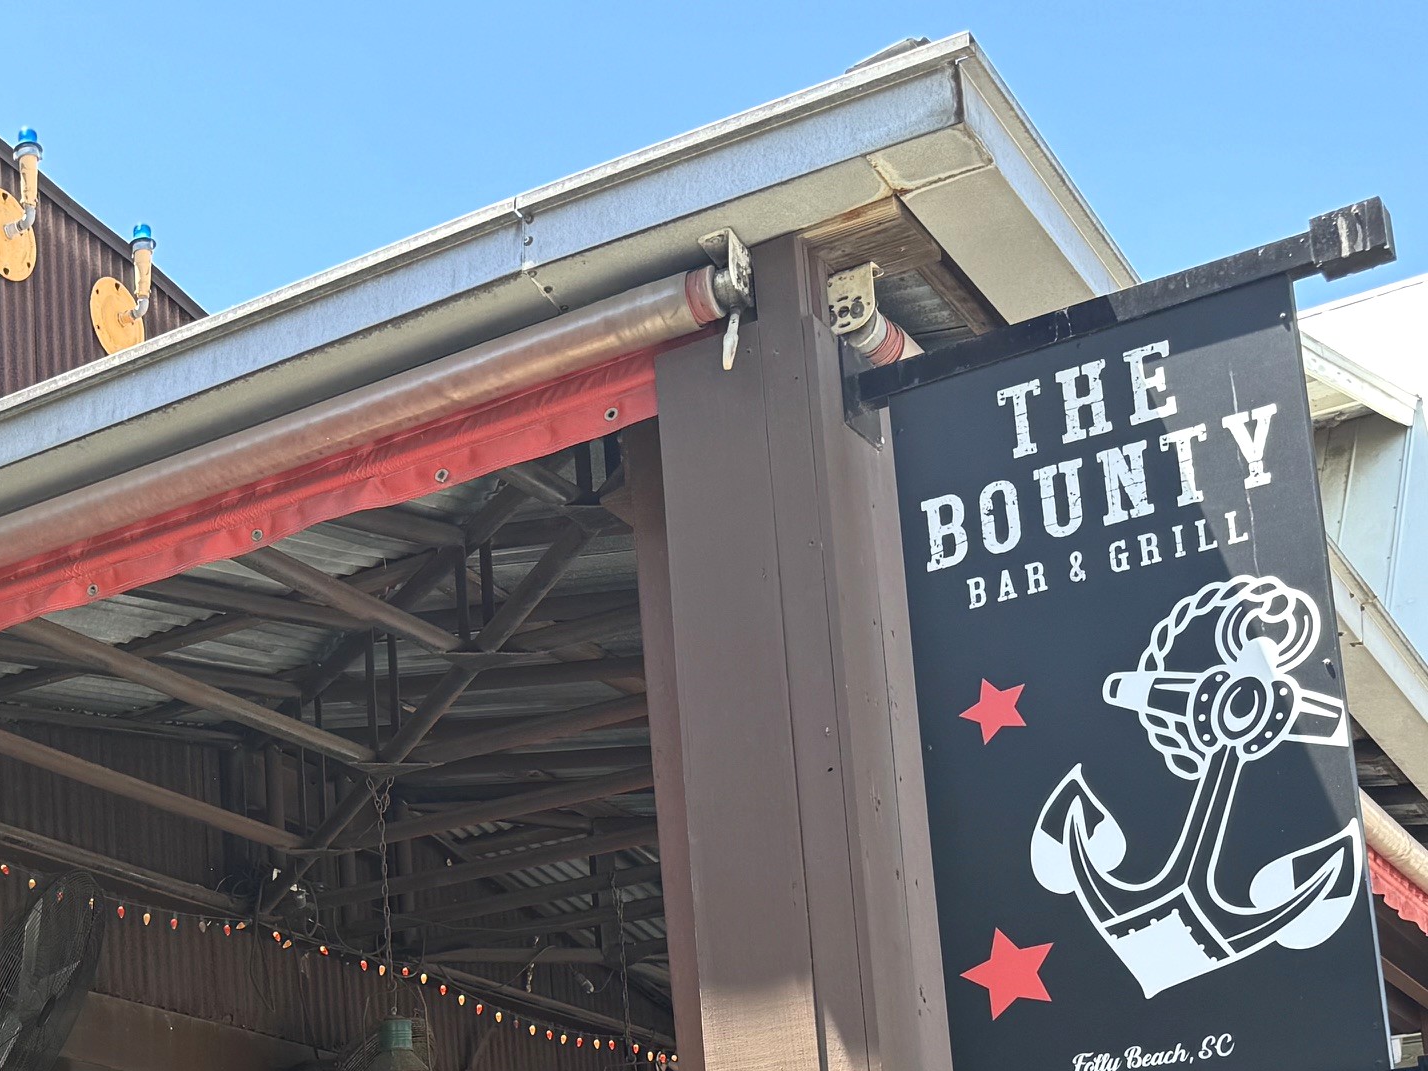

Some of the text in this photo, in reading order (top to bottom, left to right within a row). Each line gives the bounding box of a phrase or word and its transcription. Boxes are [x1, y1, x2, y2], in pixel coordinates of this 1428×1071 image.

[997, 340, 1177, 459] THE
[921, 403, 1277, 572] BOUNTY
[966, 511, 1249, 610] BAR & GRILL
[1124, 1042, 1194, 1069] Beach,
[1198, 1033, 1235, 1060] SC
